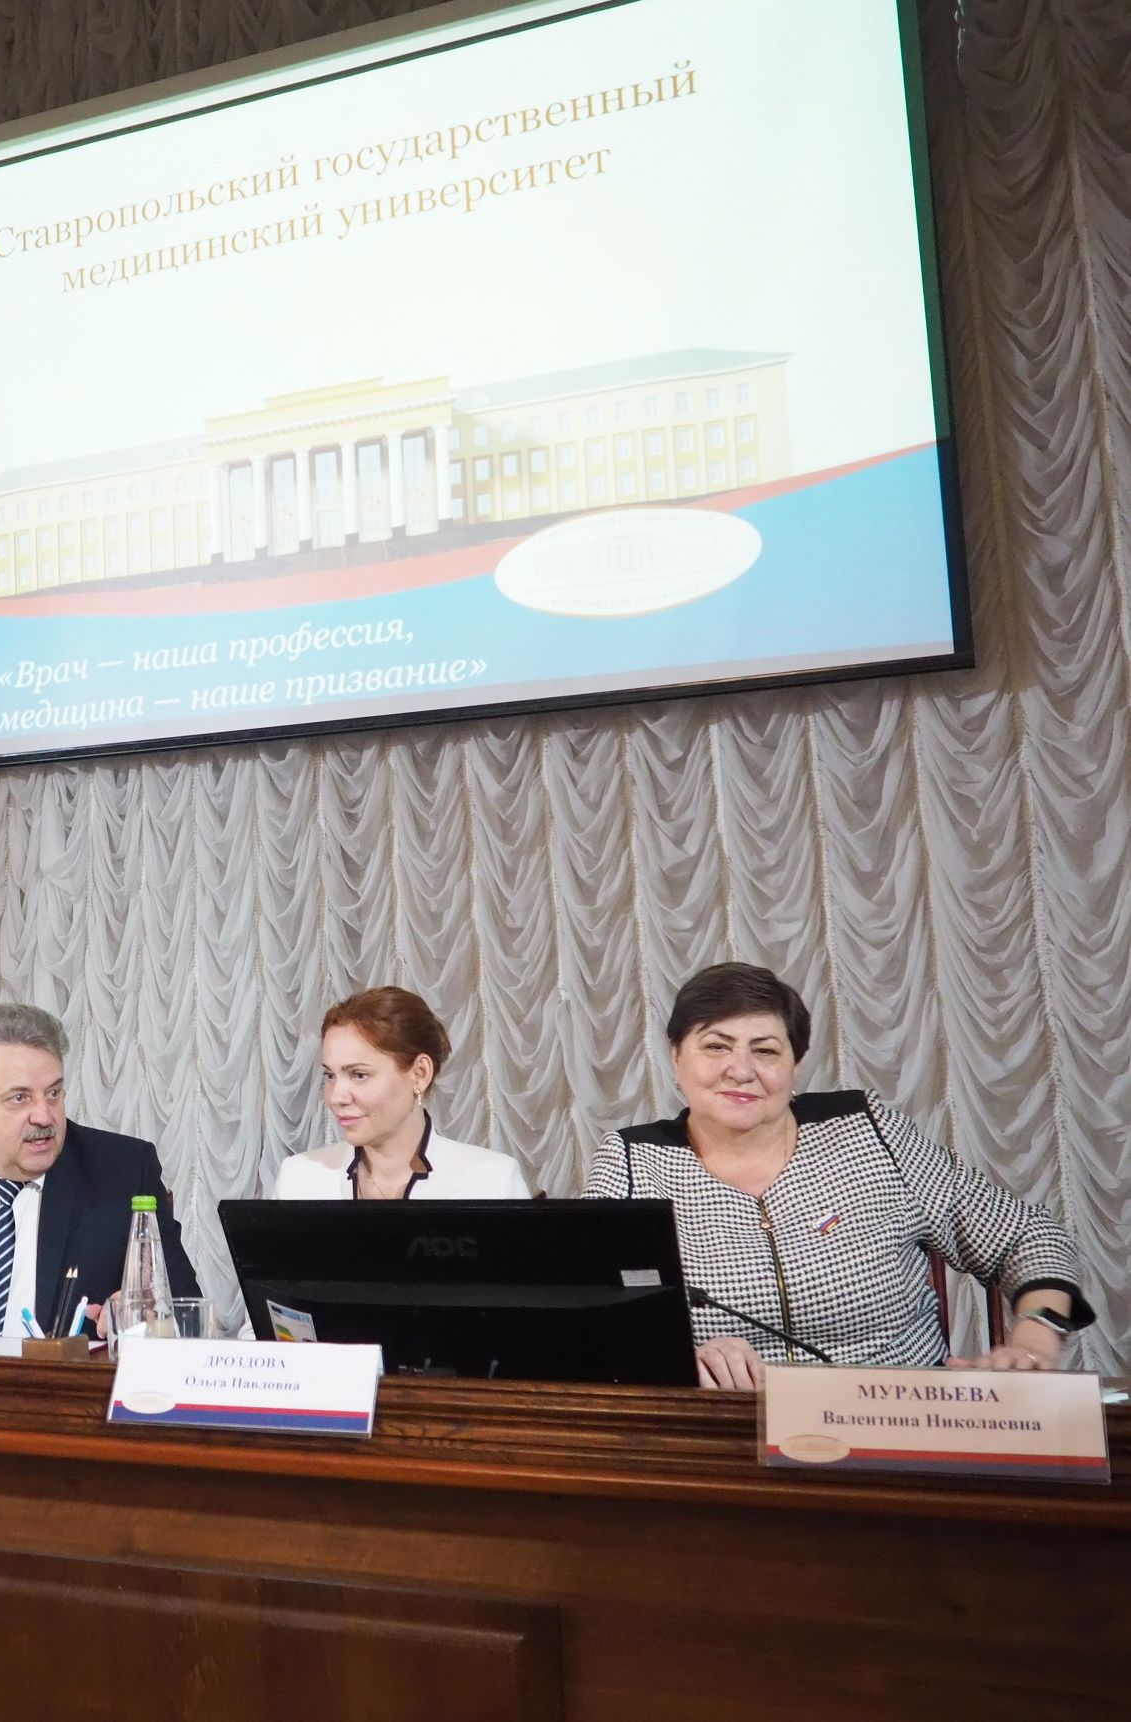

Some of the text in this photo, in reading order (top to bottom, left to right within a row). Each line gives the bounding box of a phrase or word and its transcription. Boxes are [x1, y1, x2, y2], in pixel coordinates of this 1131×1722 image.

[313, 60, 699, 184] государственный
[61, 148, 611, 293] медицинский университет
[133, 642, 217, 673] наша
[228, 617, 414, 673] профессия,
[191, 680, 274, 712] наше
[286, 655, 488, 708] призвание»
[203, 1355, 287, 1369] ДРОЗДОВА
[185, 1375, 301, 1391] Ольга Павловна
[857, 1384, 1000, 1403] МУРАВЬЕВА
[822, 1409, 1042, 1432] Валентина Николаевна
